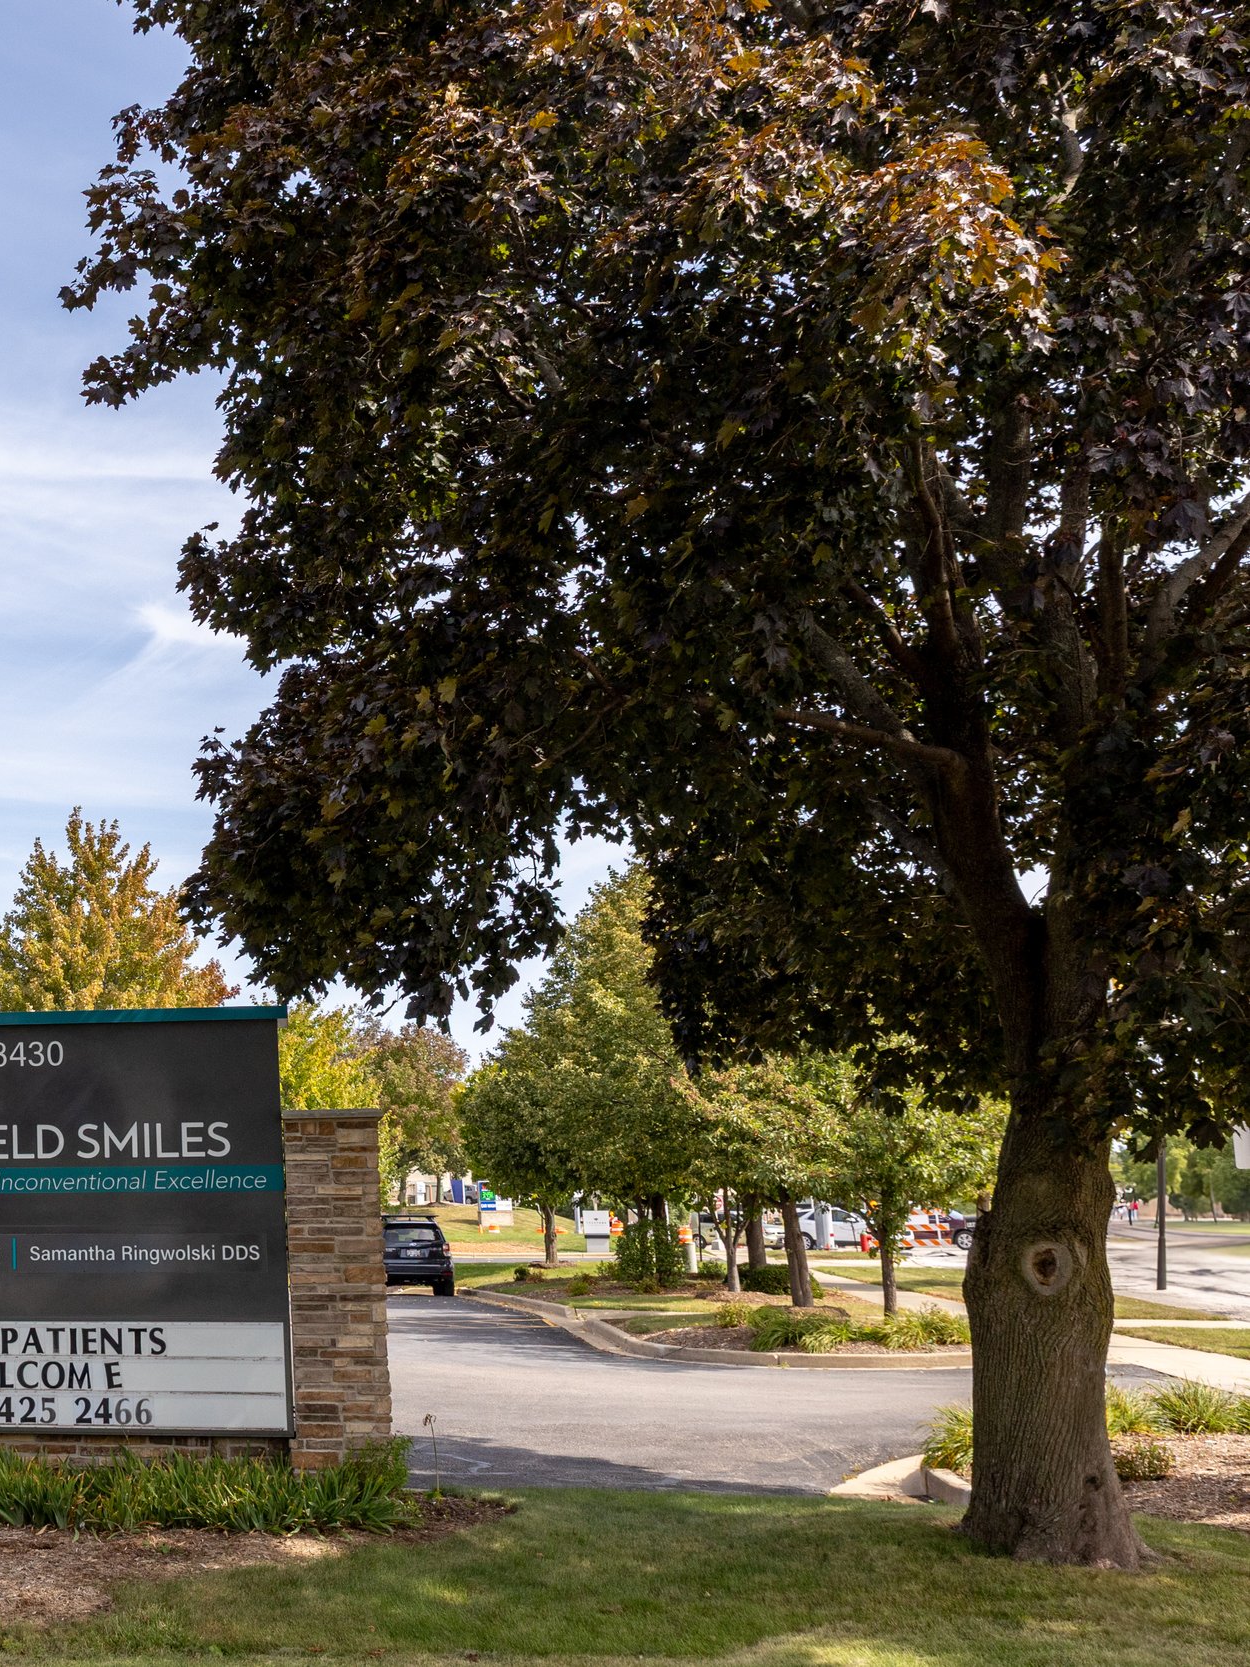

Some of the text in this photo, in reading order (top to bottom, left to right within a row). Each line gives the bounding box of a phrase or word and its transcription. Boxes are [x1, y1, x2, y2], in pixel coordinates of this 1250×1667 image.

[76, 1121, 231, 1159] SMILES
[154, 1169, 267, 1189] Excellence
[29, 1244, 261, 1265] Samantha Ringwolski DDS
[0, 1327, 167, 1355] PATIENTS
[74, 1397, 153, 1425] 2466
